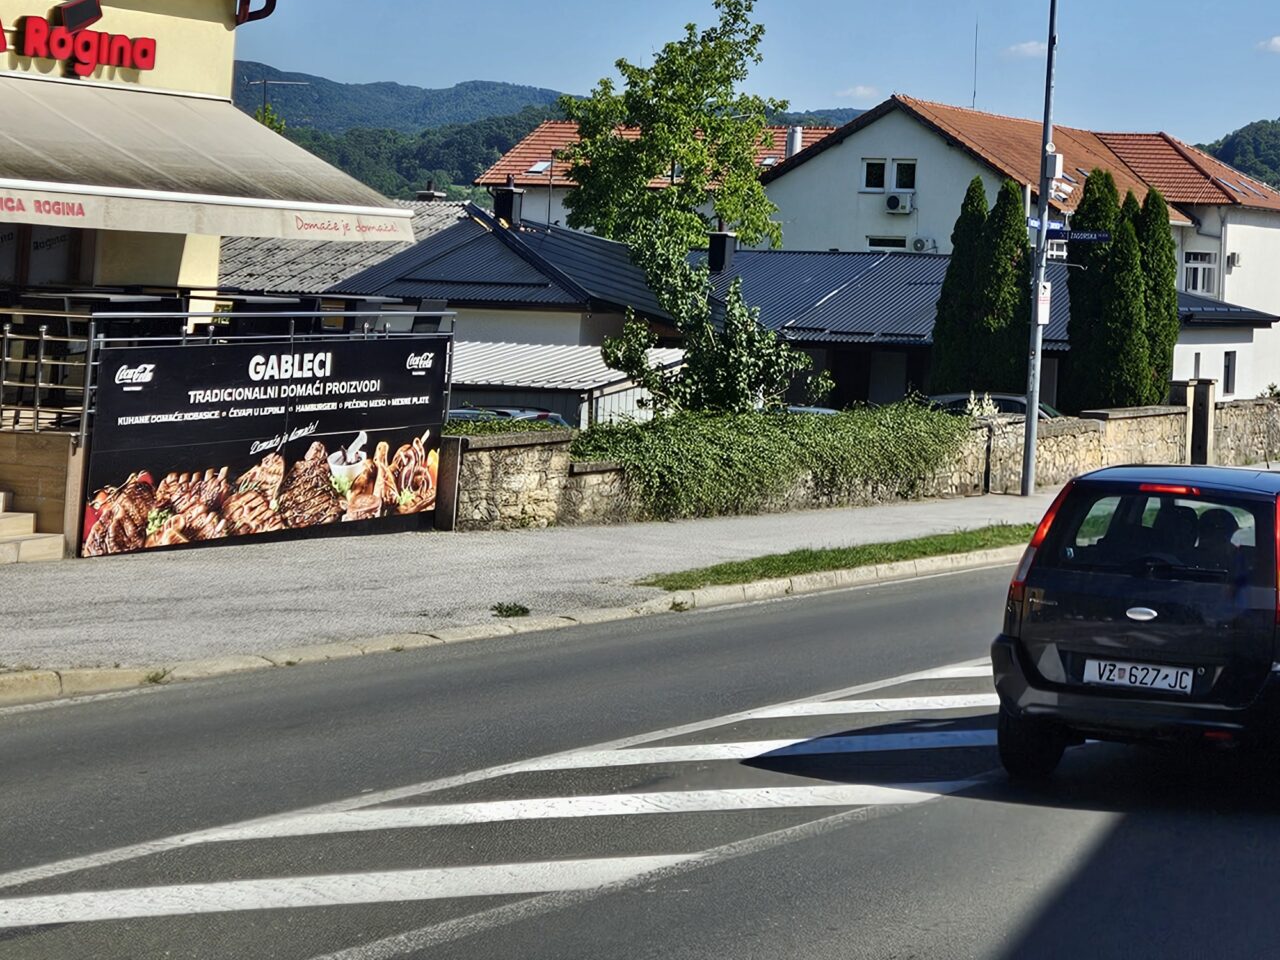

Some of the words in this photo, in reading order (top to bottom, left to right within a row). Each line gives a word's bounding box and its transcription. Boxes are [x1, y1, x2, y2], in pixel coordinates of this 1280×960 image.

[24, 15, 156, 77] Rogina
[34, 199, 85, 216] ROGINA
[248, 352, 332, 381] GABLECI
[188, 386, 278, 404] TRADICIONALNI
[280, 380, 323, 398] DOMAĆI
[325, 379, 381, 395] PROIZVODI
[117, 415, 150, 426] KUHANE
